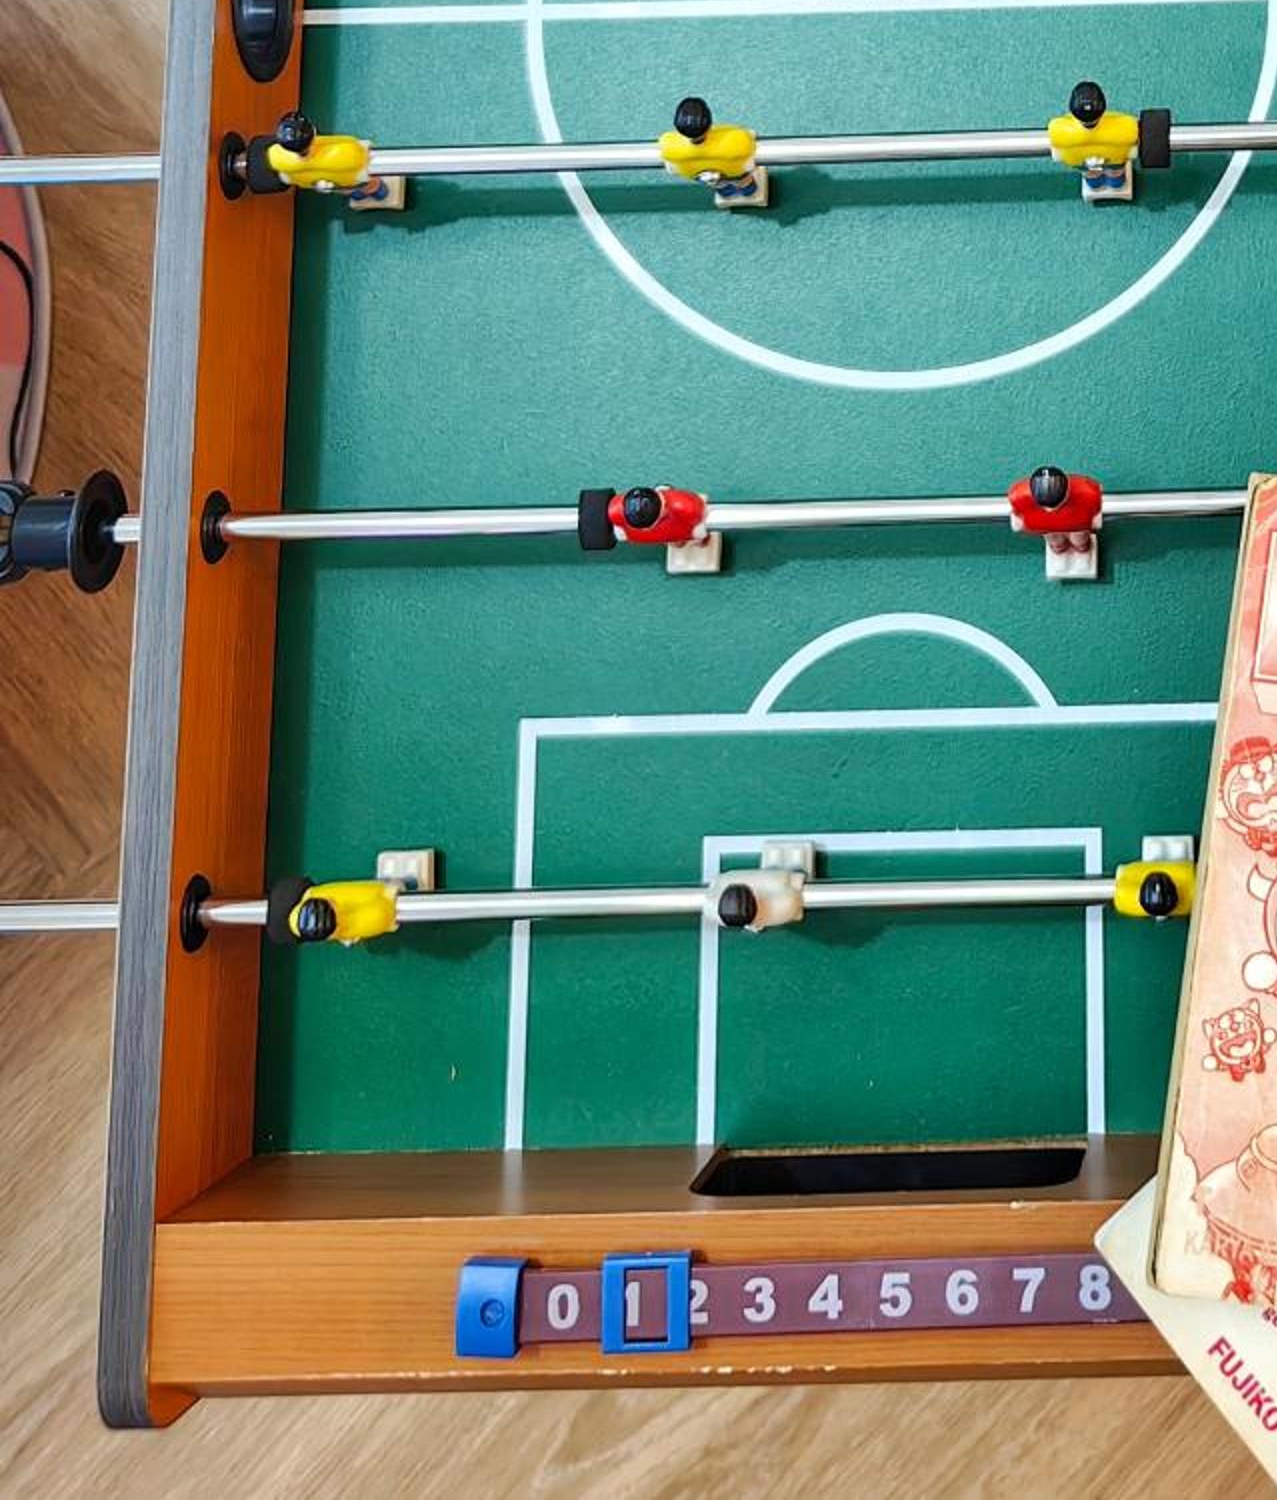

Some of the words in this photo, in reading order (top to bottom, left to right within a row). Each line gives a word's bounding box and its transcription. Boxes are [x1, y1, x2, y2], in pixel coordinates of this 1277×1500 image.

[549, 1283, 580, 1330] 0
[626, 1281, 640, 1328] 1
[743, 1277, 777, 1323] 3
[807, 1273, 843, 1320] 4
[879, 1272, 912, 1318] 5
[945, 1269, 979, 1316] 6
[1012, 1267, 1046, 1313] 7
[1078, 1264, 1112, 1312] 8
